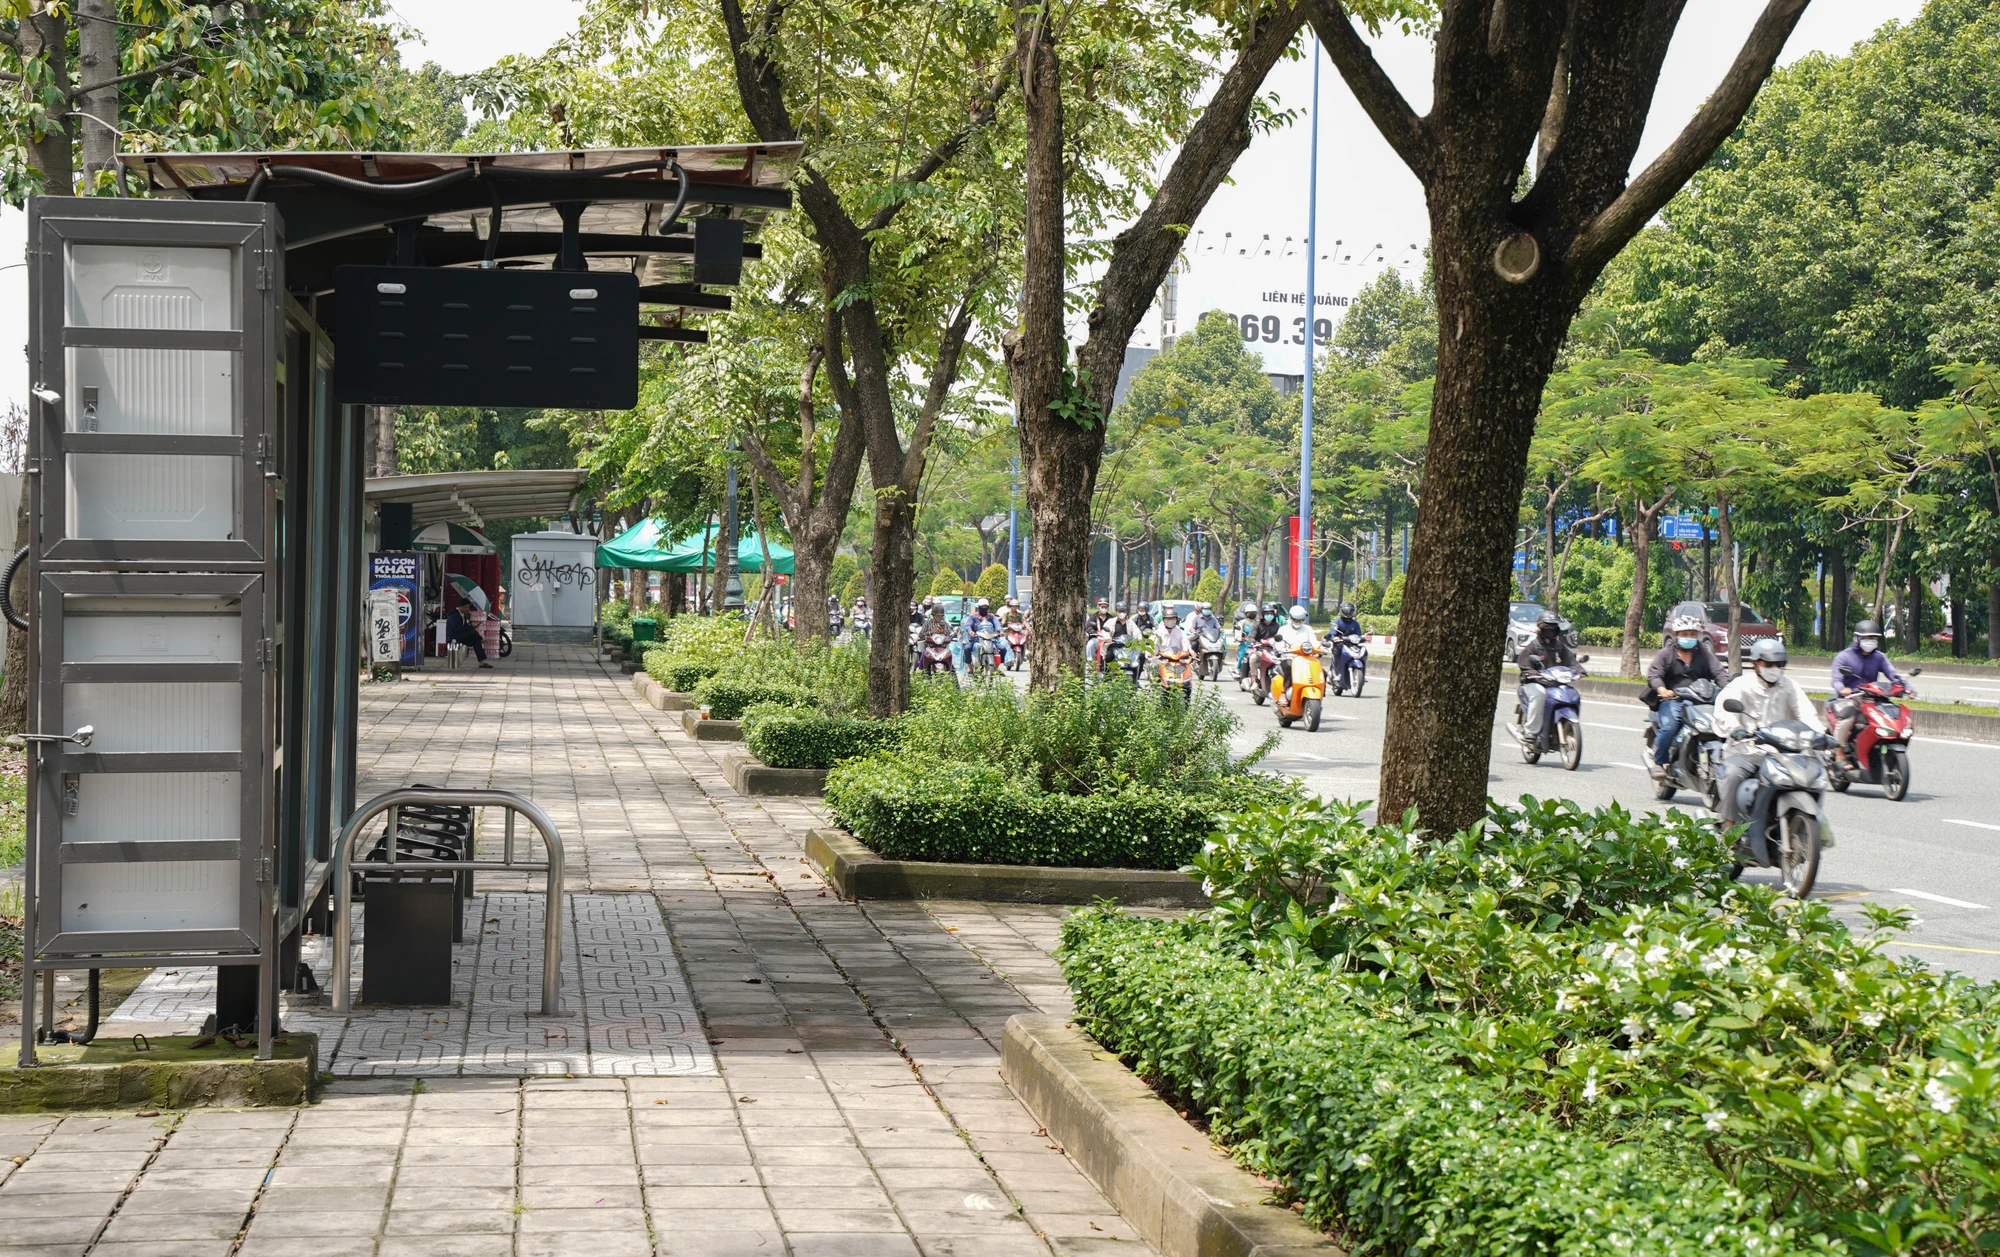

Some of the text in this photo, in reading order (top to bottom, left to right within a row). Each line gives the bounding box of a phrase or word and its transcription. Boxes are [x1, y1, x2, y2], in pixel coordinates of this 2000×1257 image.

[1262, 290, 1288, 303] LIÊN
[1291, 293, 1305, 306] HỆ
[1313, 293, 1348, 306] UẢNG
[1198, 312, 1332, 346] 69.39
[374, 556, 390, 564] ĐÃ
[374, 565, 415, 574] KHÁT
[399, 606, 409, 614] SI
